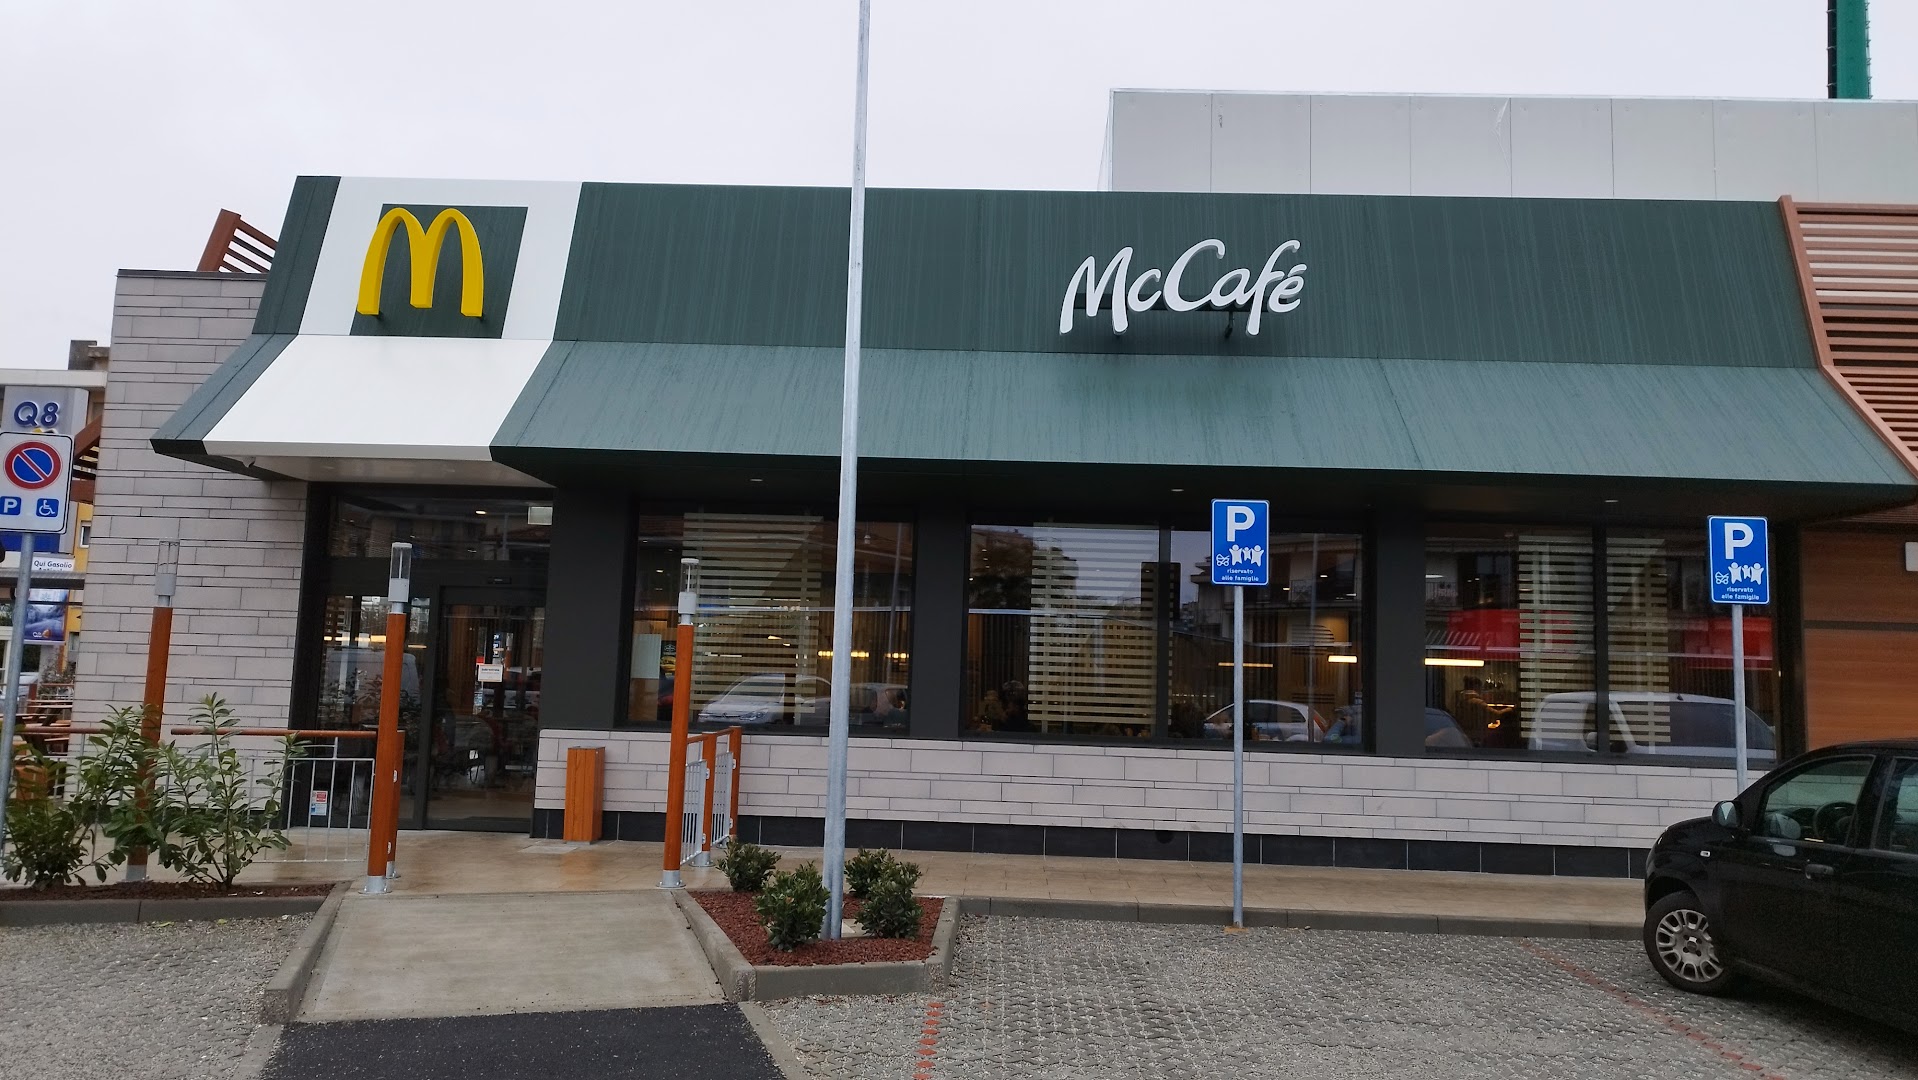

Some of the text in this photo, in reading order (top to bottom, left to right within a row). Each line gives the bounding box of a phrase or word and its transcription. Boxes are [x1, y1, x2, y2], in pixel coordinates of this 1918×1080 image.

[1059, 238, 1308, 336] McCafé
[13, 401, 60, 427] Q8
[3, 498, 18, 513] P
[1226, 505, 1256, 542] P
[1724, 522, 1754, 560] P
[34, 560, 46, 568] Qui
[47, 560, 72, 569] Gasolio
[1226, 567, 1254, 575] riservato
[1734, 593, 1760, 601] famiglie
